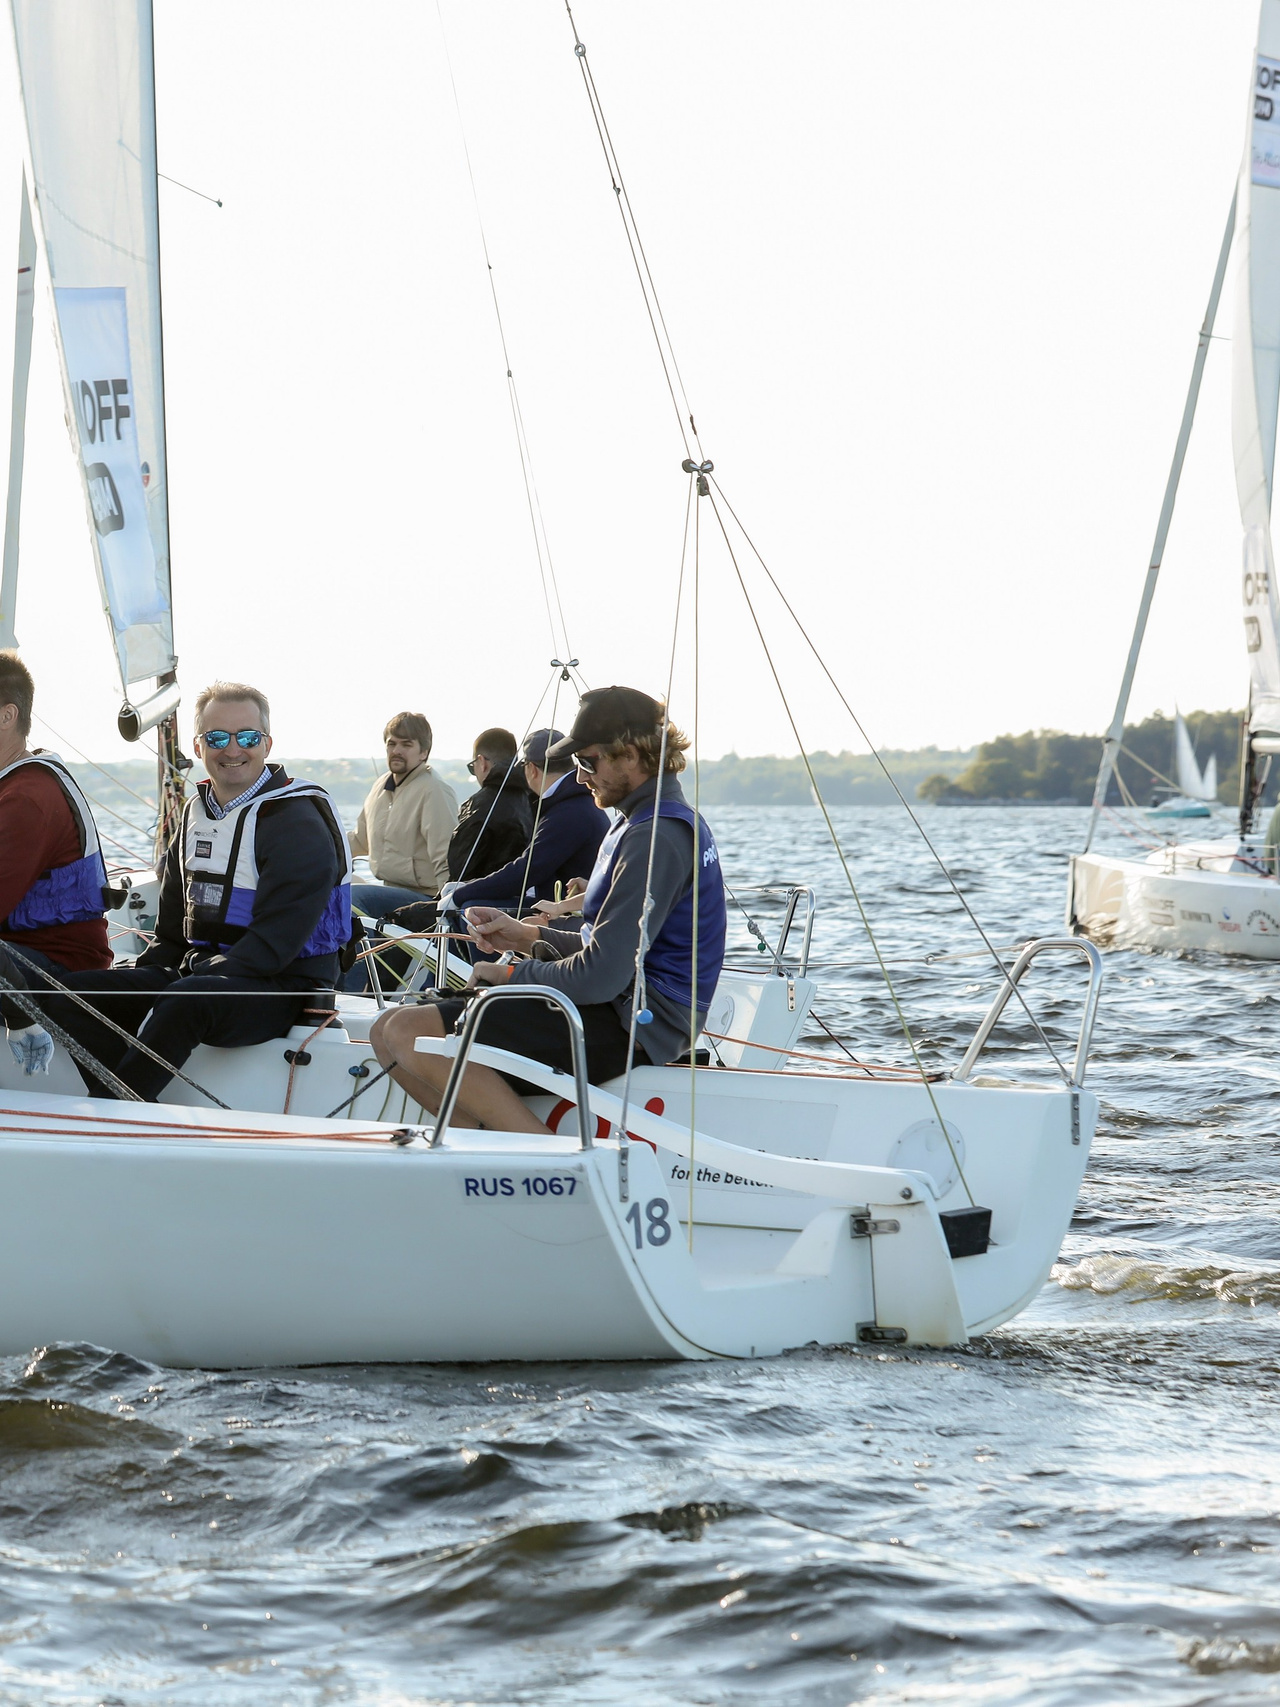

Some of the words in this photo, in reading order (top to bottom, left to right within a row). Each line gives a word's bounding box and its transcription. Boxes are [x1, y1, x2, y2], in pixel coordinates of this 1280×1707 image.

[697, 1168, 721, 1183] the
[464, 1177, 515, 1197] RUS
[521, 1176, 577, 1197] 1067
[625, 1197, 671, 1250] 18
